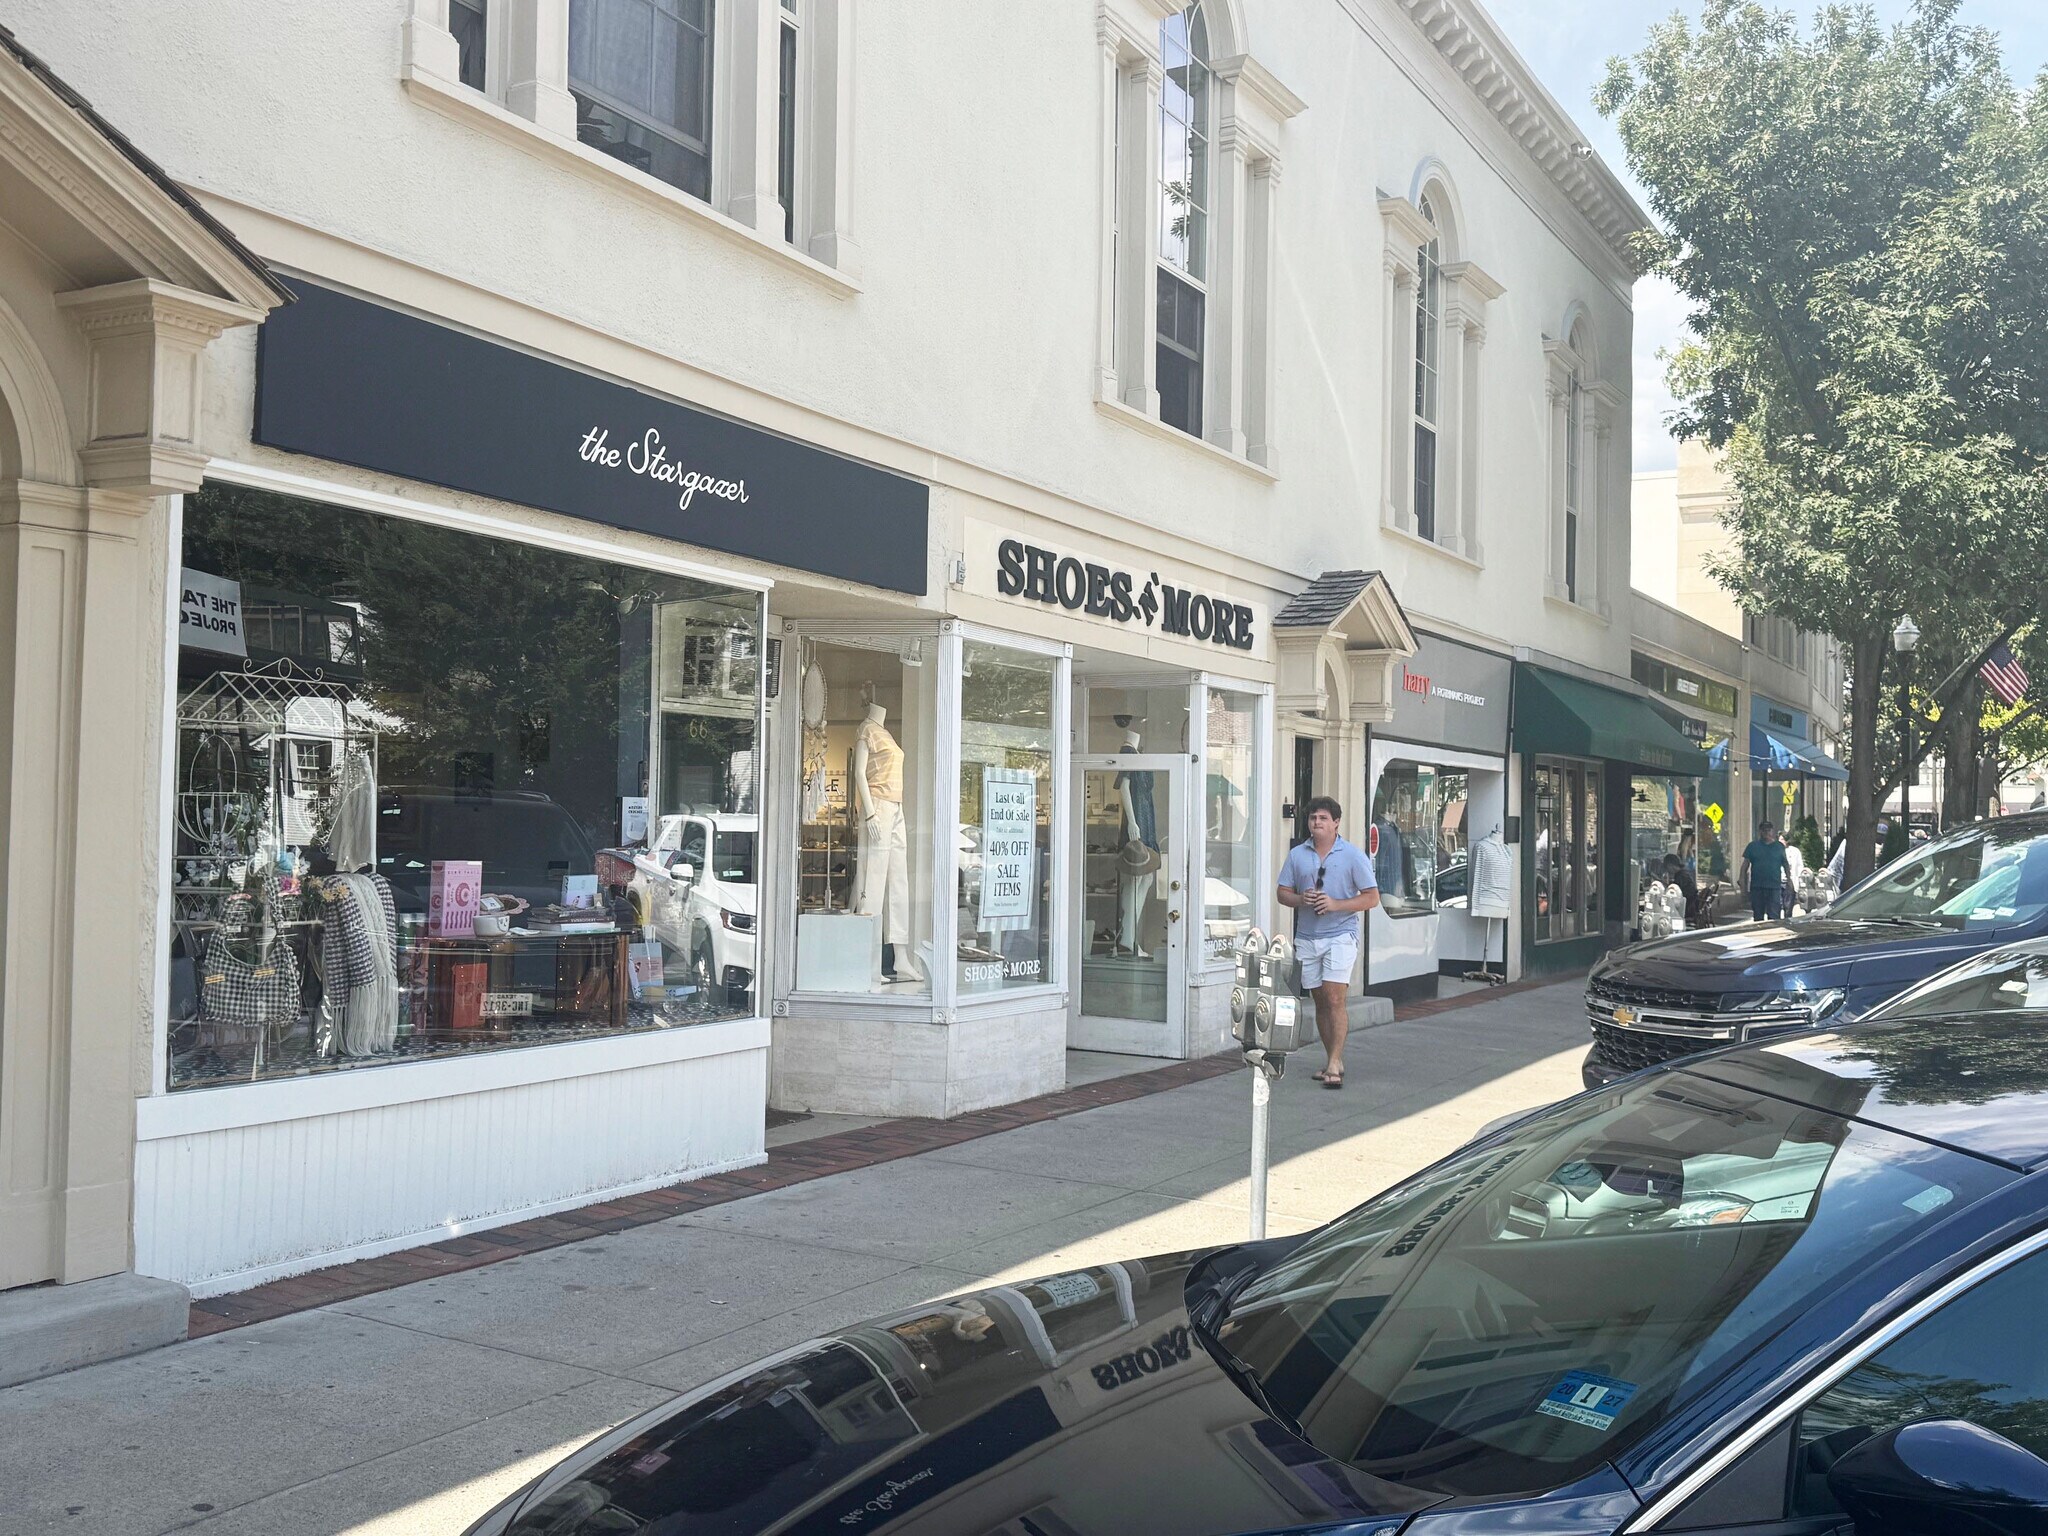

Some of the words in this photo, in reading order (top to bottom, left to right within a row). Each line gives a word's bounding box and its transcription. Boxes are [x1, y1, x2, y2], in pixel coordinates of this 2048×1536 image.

[578, 426, 622, 467] the
[627, 428, 749, 510] Stargazer
[997, 539, 1133, 622] SHOES
[1161, 585, 1254, 650] MORE
[690, 719, 707, 738] 66
[995, 792, 1010, 803] Last
[990, 808, 1004, 820] End
[1005, 808, 1014, 820] Of
[1016, 809, 1030, 821] Sale
[990, 840, 1008, 856] 40%
[1011, 840, 1029, 856] OFF
[997, 864, 1020, 878] SALE
[994, 882, 1021, 897] ITEMS
[964, 964, 1001, 982] SHOES
[1010, 960, 1041, 977] MORE
[1557, 1383, 1576, 1395] 20
[1580, 1386, 1597, 1403] 1
[1602, 1395, 1624, 1407] 27
